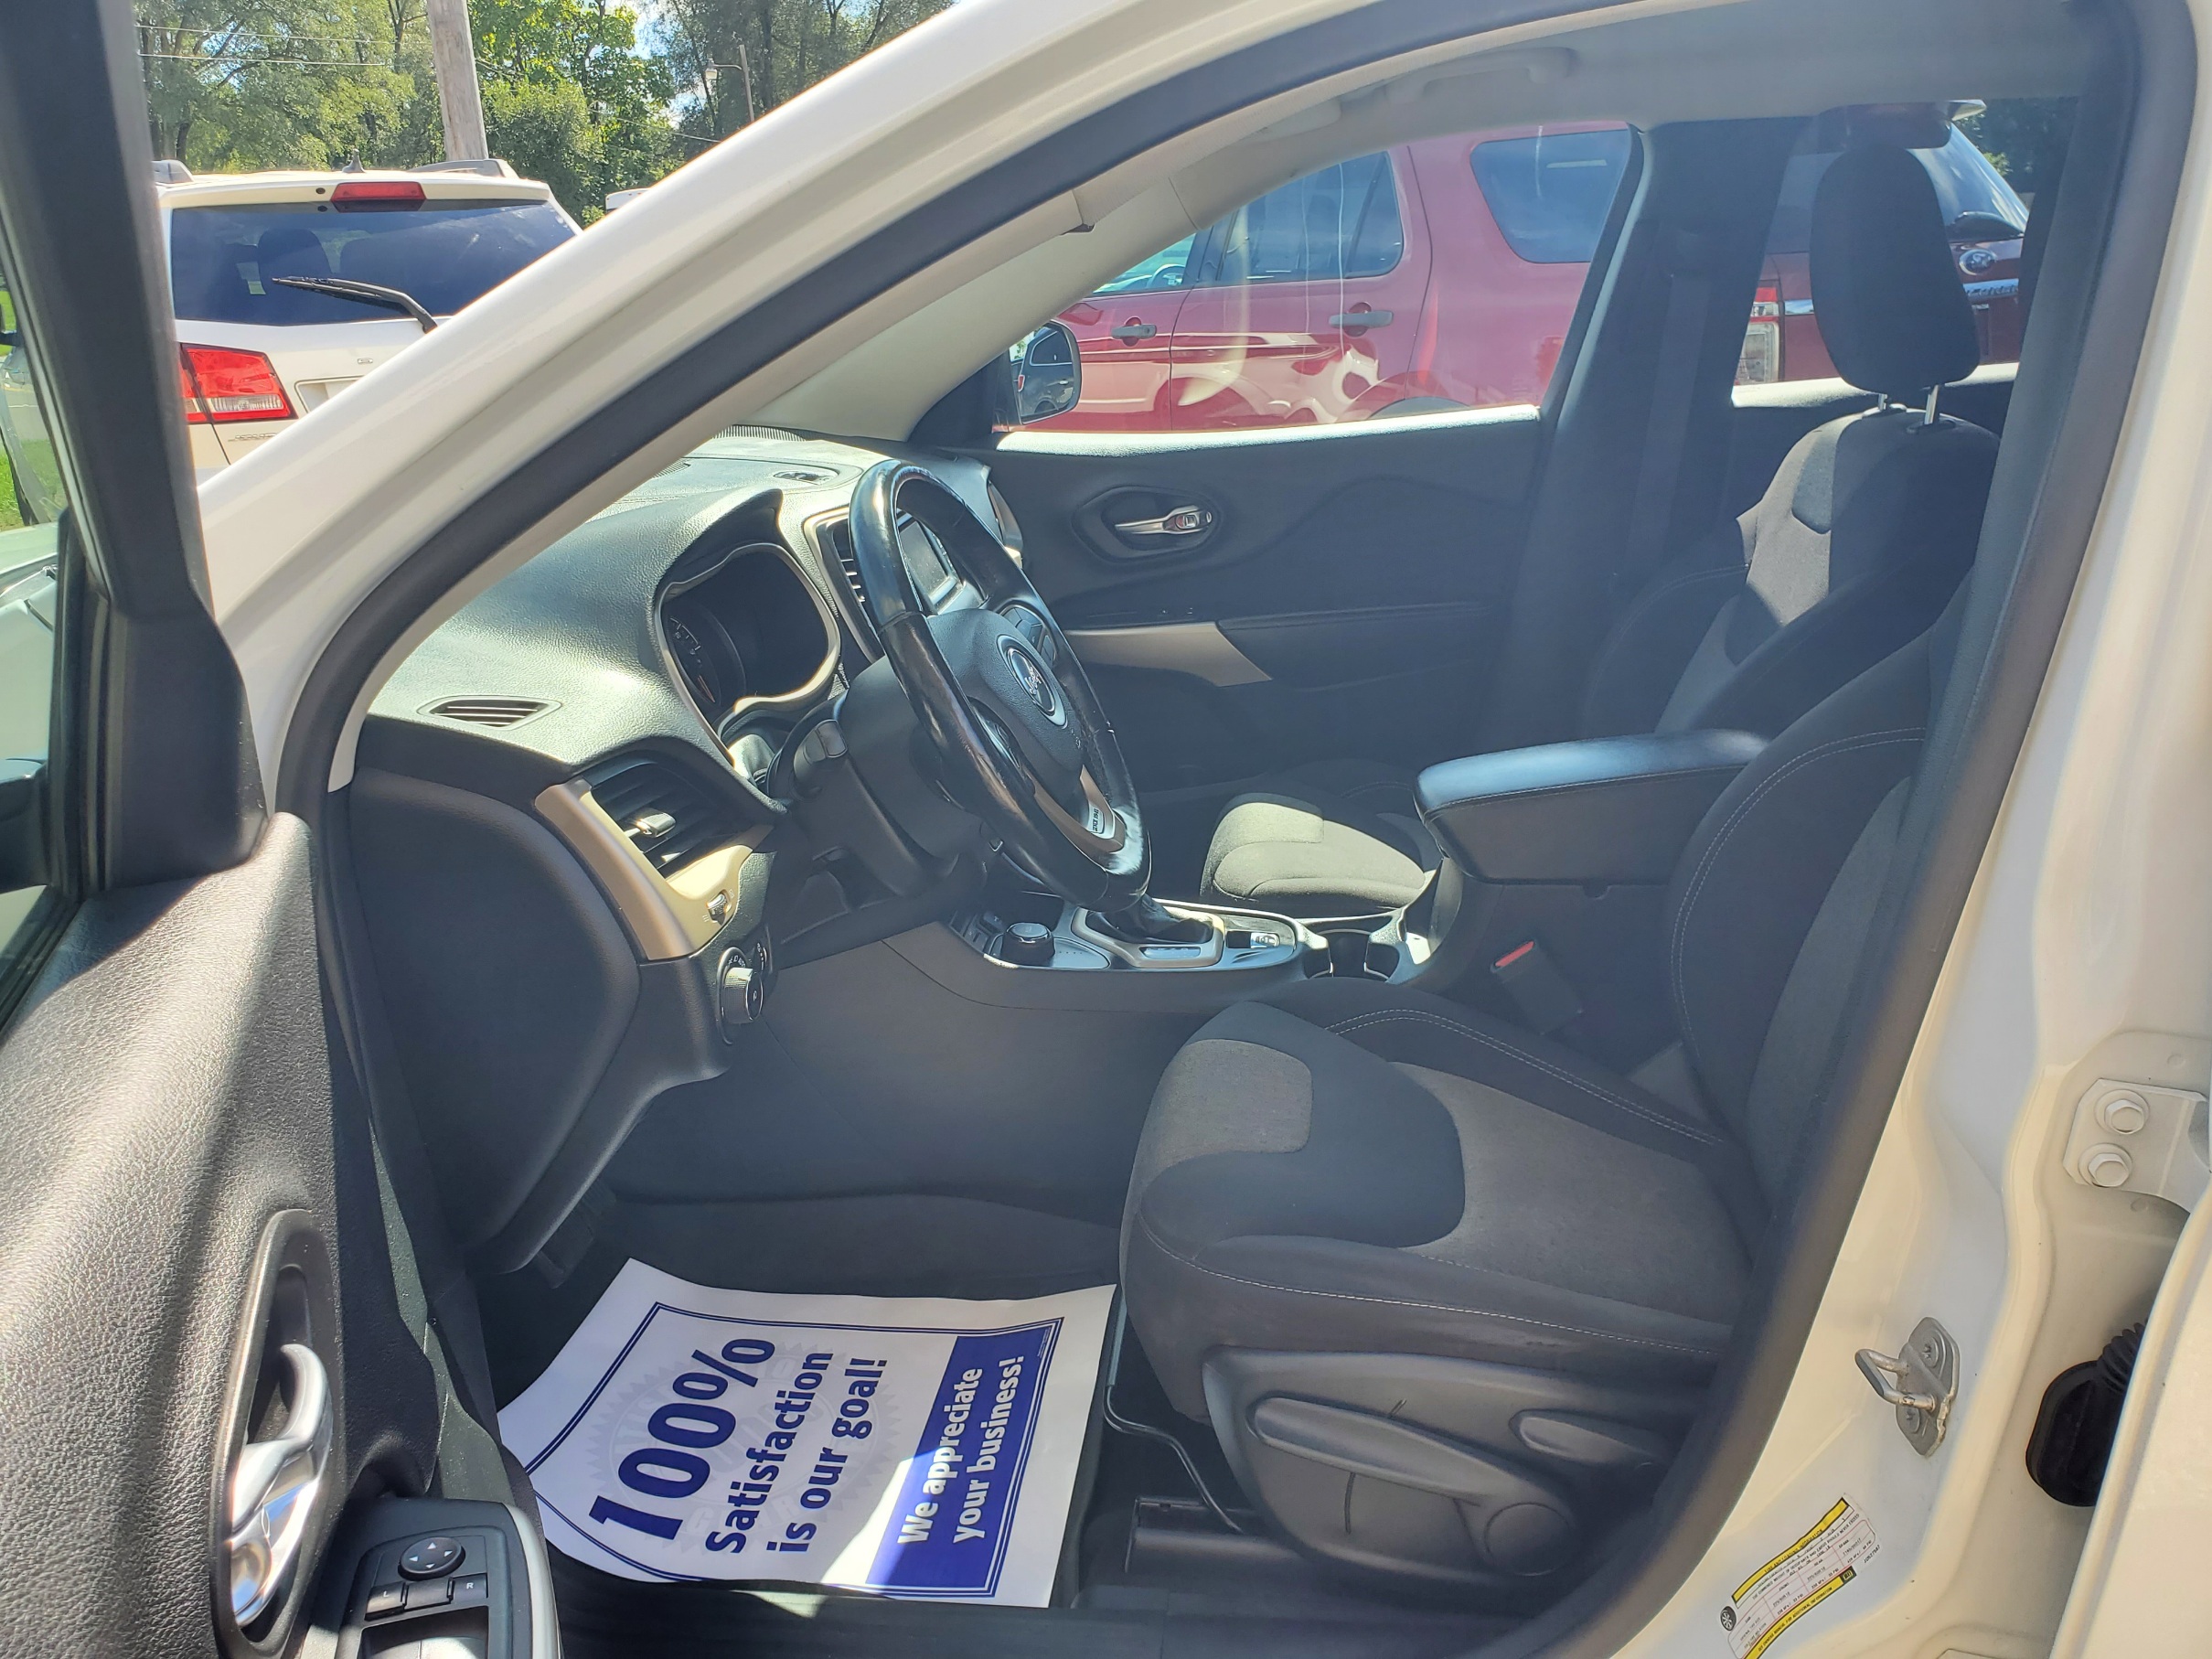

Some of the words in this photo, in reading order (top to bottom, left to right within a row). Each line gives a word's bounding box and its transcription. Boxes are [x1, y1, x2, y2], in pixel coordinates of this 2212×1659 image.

[589, 1339, 775, 1540] 100%
[705, 1353, 834, 1554] Satisfaction
[766, 1522, 817, 1552] is
[800, 1447, 848, 1509] our
[831, 1358, 887, 1439] goal!
[897, 1502, 938, 1544] We
[923, 1368, 983, 1495] appreciate
[966, 1355, 1025, 1473] business!
[465, 1581, 474, 1589] R
[953, 1479, 989, 1544] your
